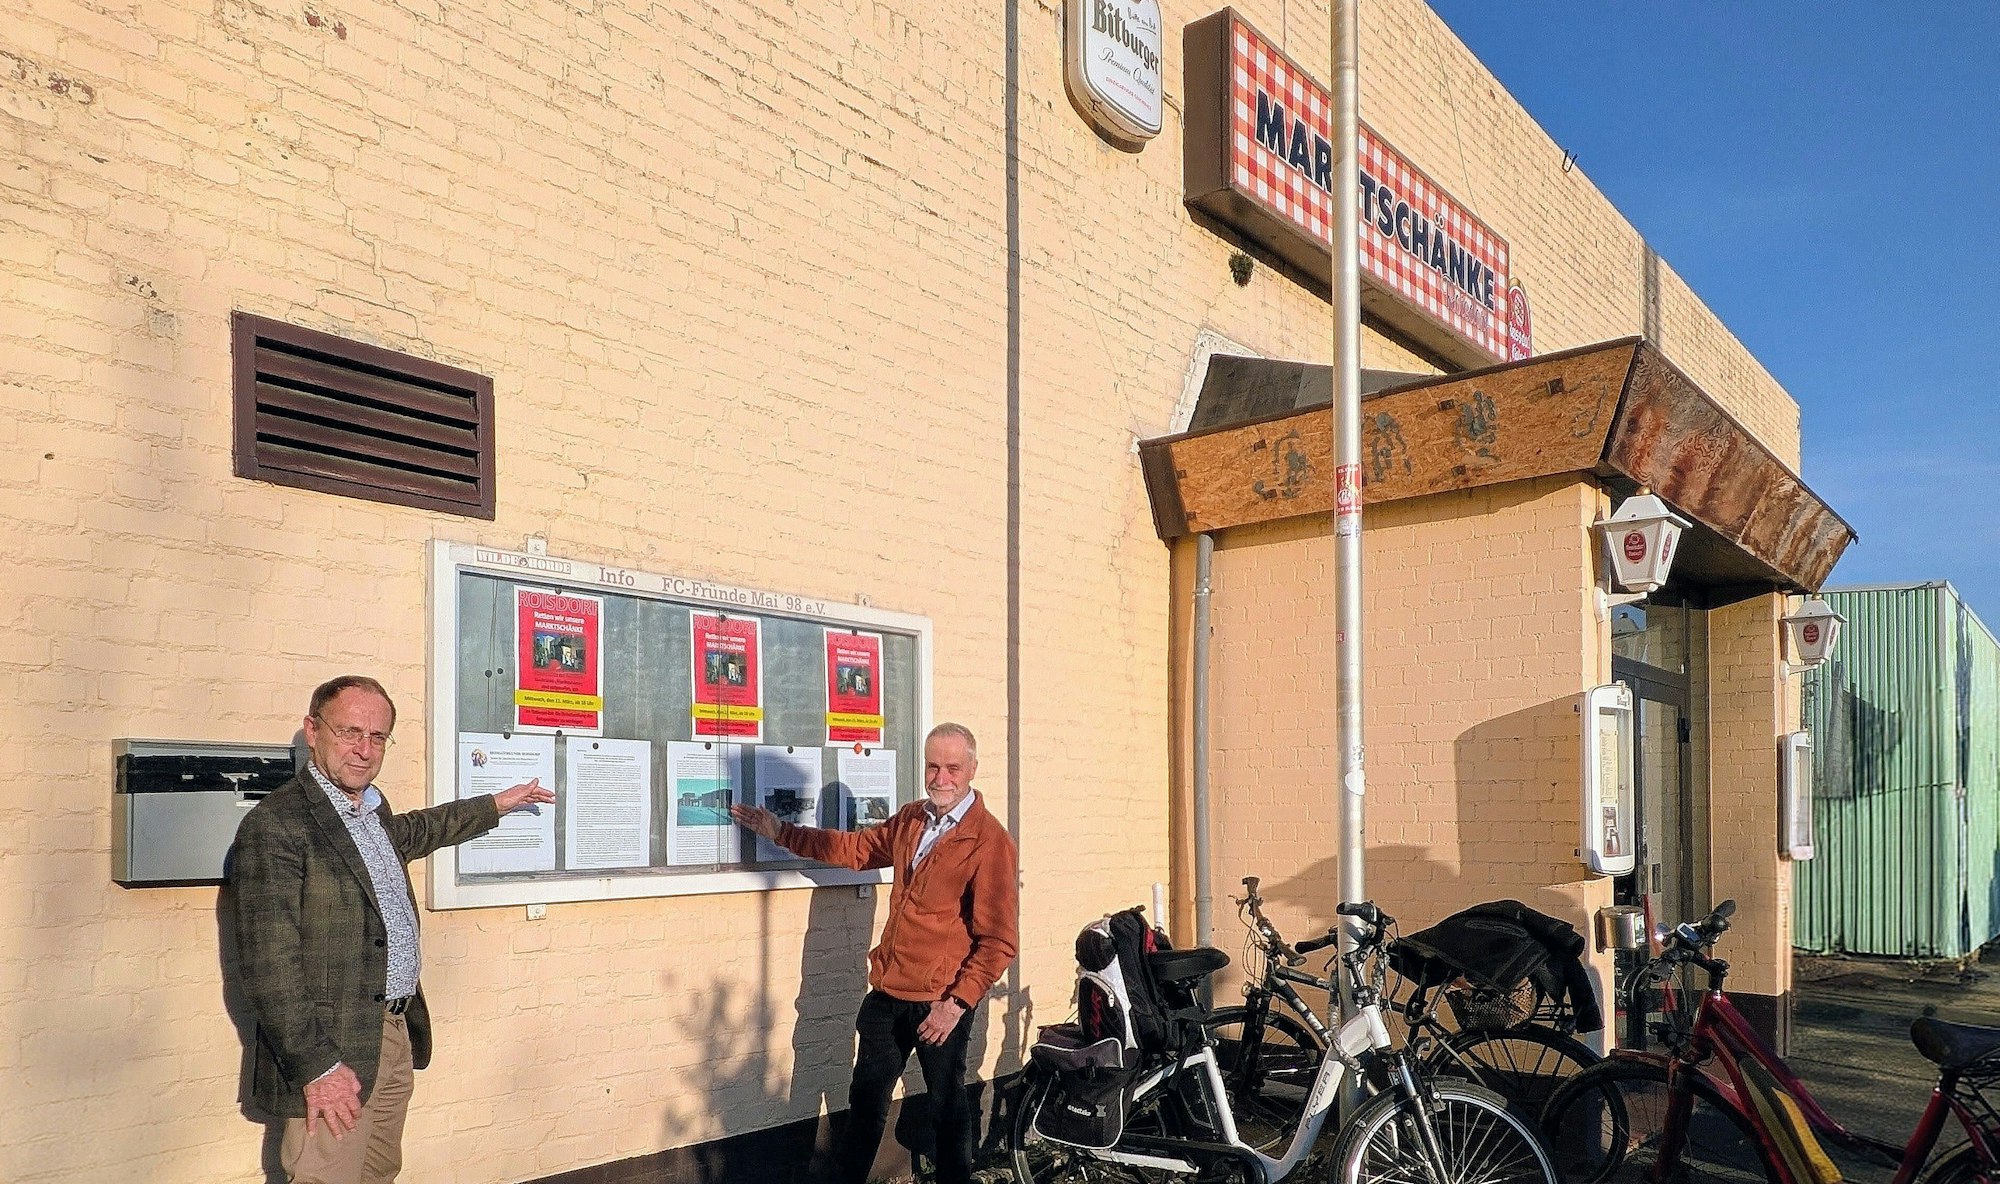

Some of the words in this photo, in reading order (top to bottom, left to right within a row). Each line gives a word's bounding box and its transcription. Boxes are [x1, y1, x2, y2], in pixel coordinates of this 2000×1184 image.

[1092, 0, 1159, 75] Bitburger
[1098, 47, 1131, 76] Premium
[1255, 87, 1495, 314] MARTSCHÄNKE
[477, 550, 519, 566] WILDE
[528, 557, 571, 574] HORDE
[599, 567, 635, 586] Info
[662, 576, 747, 604] FC-Fründe
[805, 603, 826, 615] e.V.
[534, 611, 554, 620] Retten
[565, 616, 585, 624] unsere
[535, 621, 583, 633] MARKTSCHÄNKE
